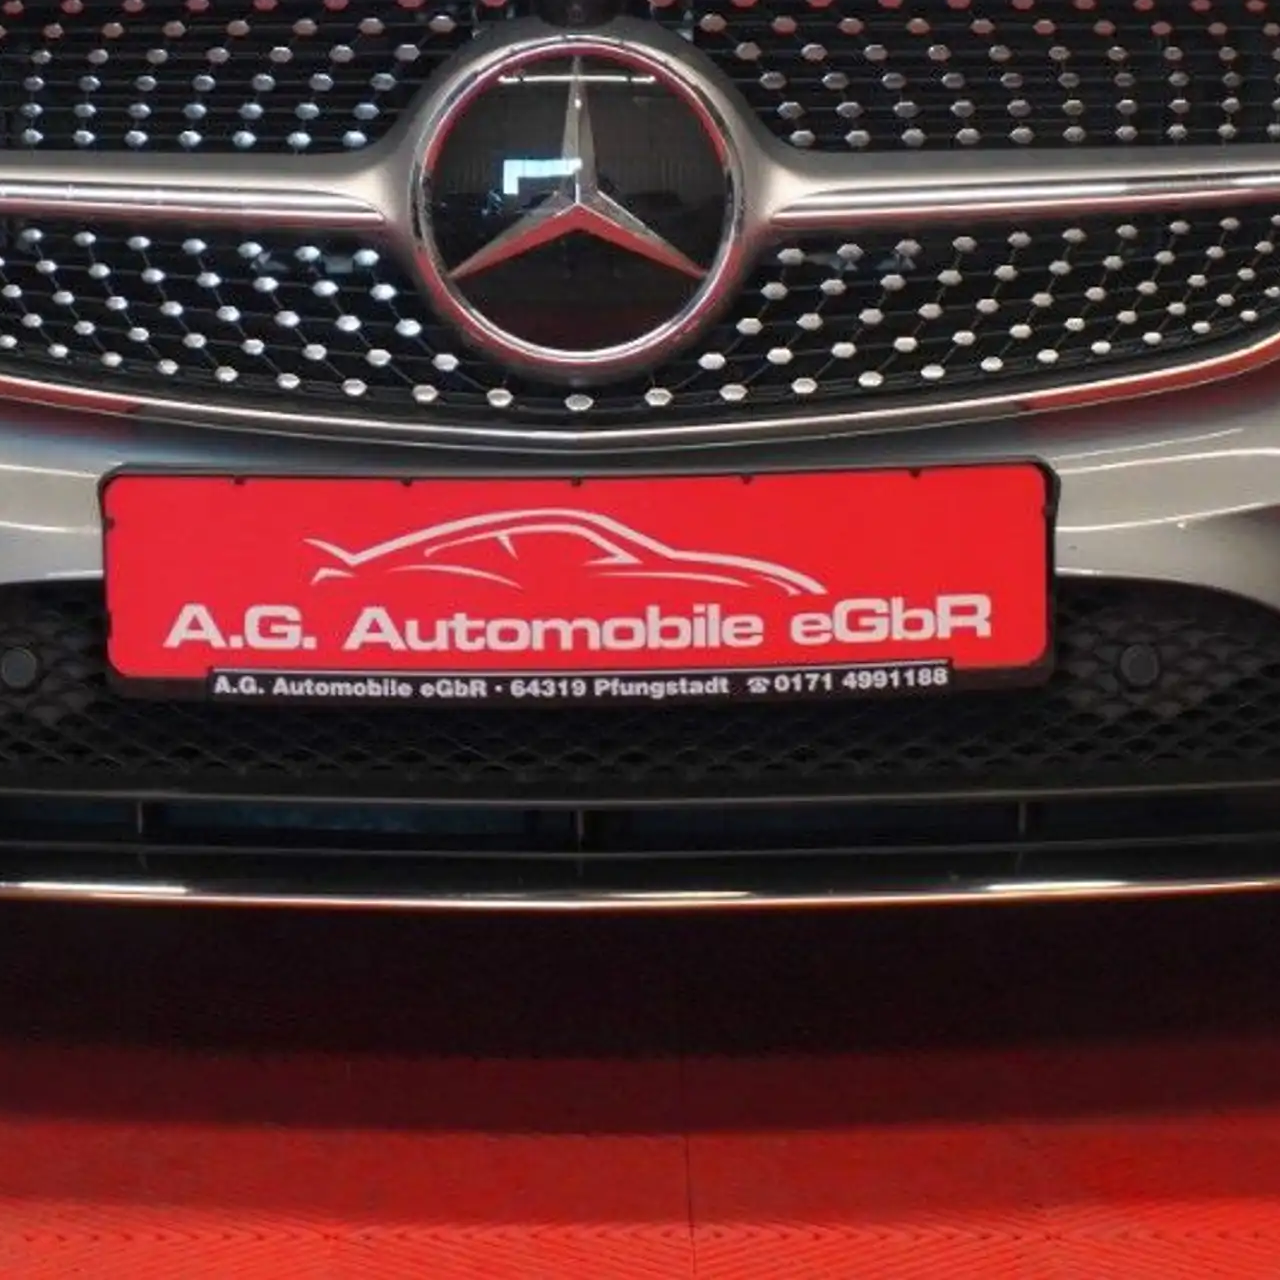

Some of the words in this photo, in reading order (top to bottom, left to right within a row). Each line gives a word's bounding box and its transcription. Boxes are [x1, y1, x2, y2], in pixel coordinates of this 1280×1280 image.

[163, 603, 317, 650] A.G.
[342, 603, 764, 652] Automobile
[790, 593, 992, 646] eGbR
[214, 675, 265, 695] A.G.
[272, 676, 414, 697] Automobile
[419, 678, 488, 698] eGbR
[510, 678, 587, 698] 64319
[593, 676, 730, 700] Pfungstadt
[773, 673, 832, 692] 0171
[841, 667, 948, 690] 4991188
